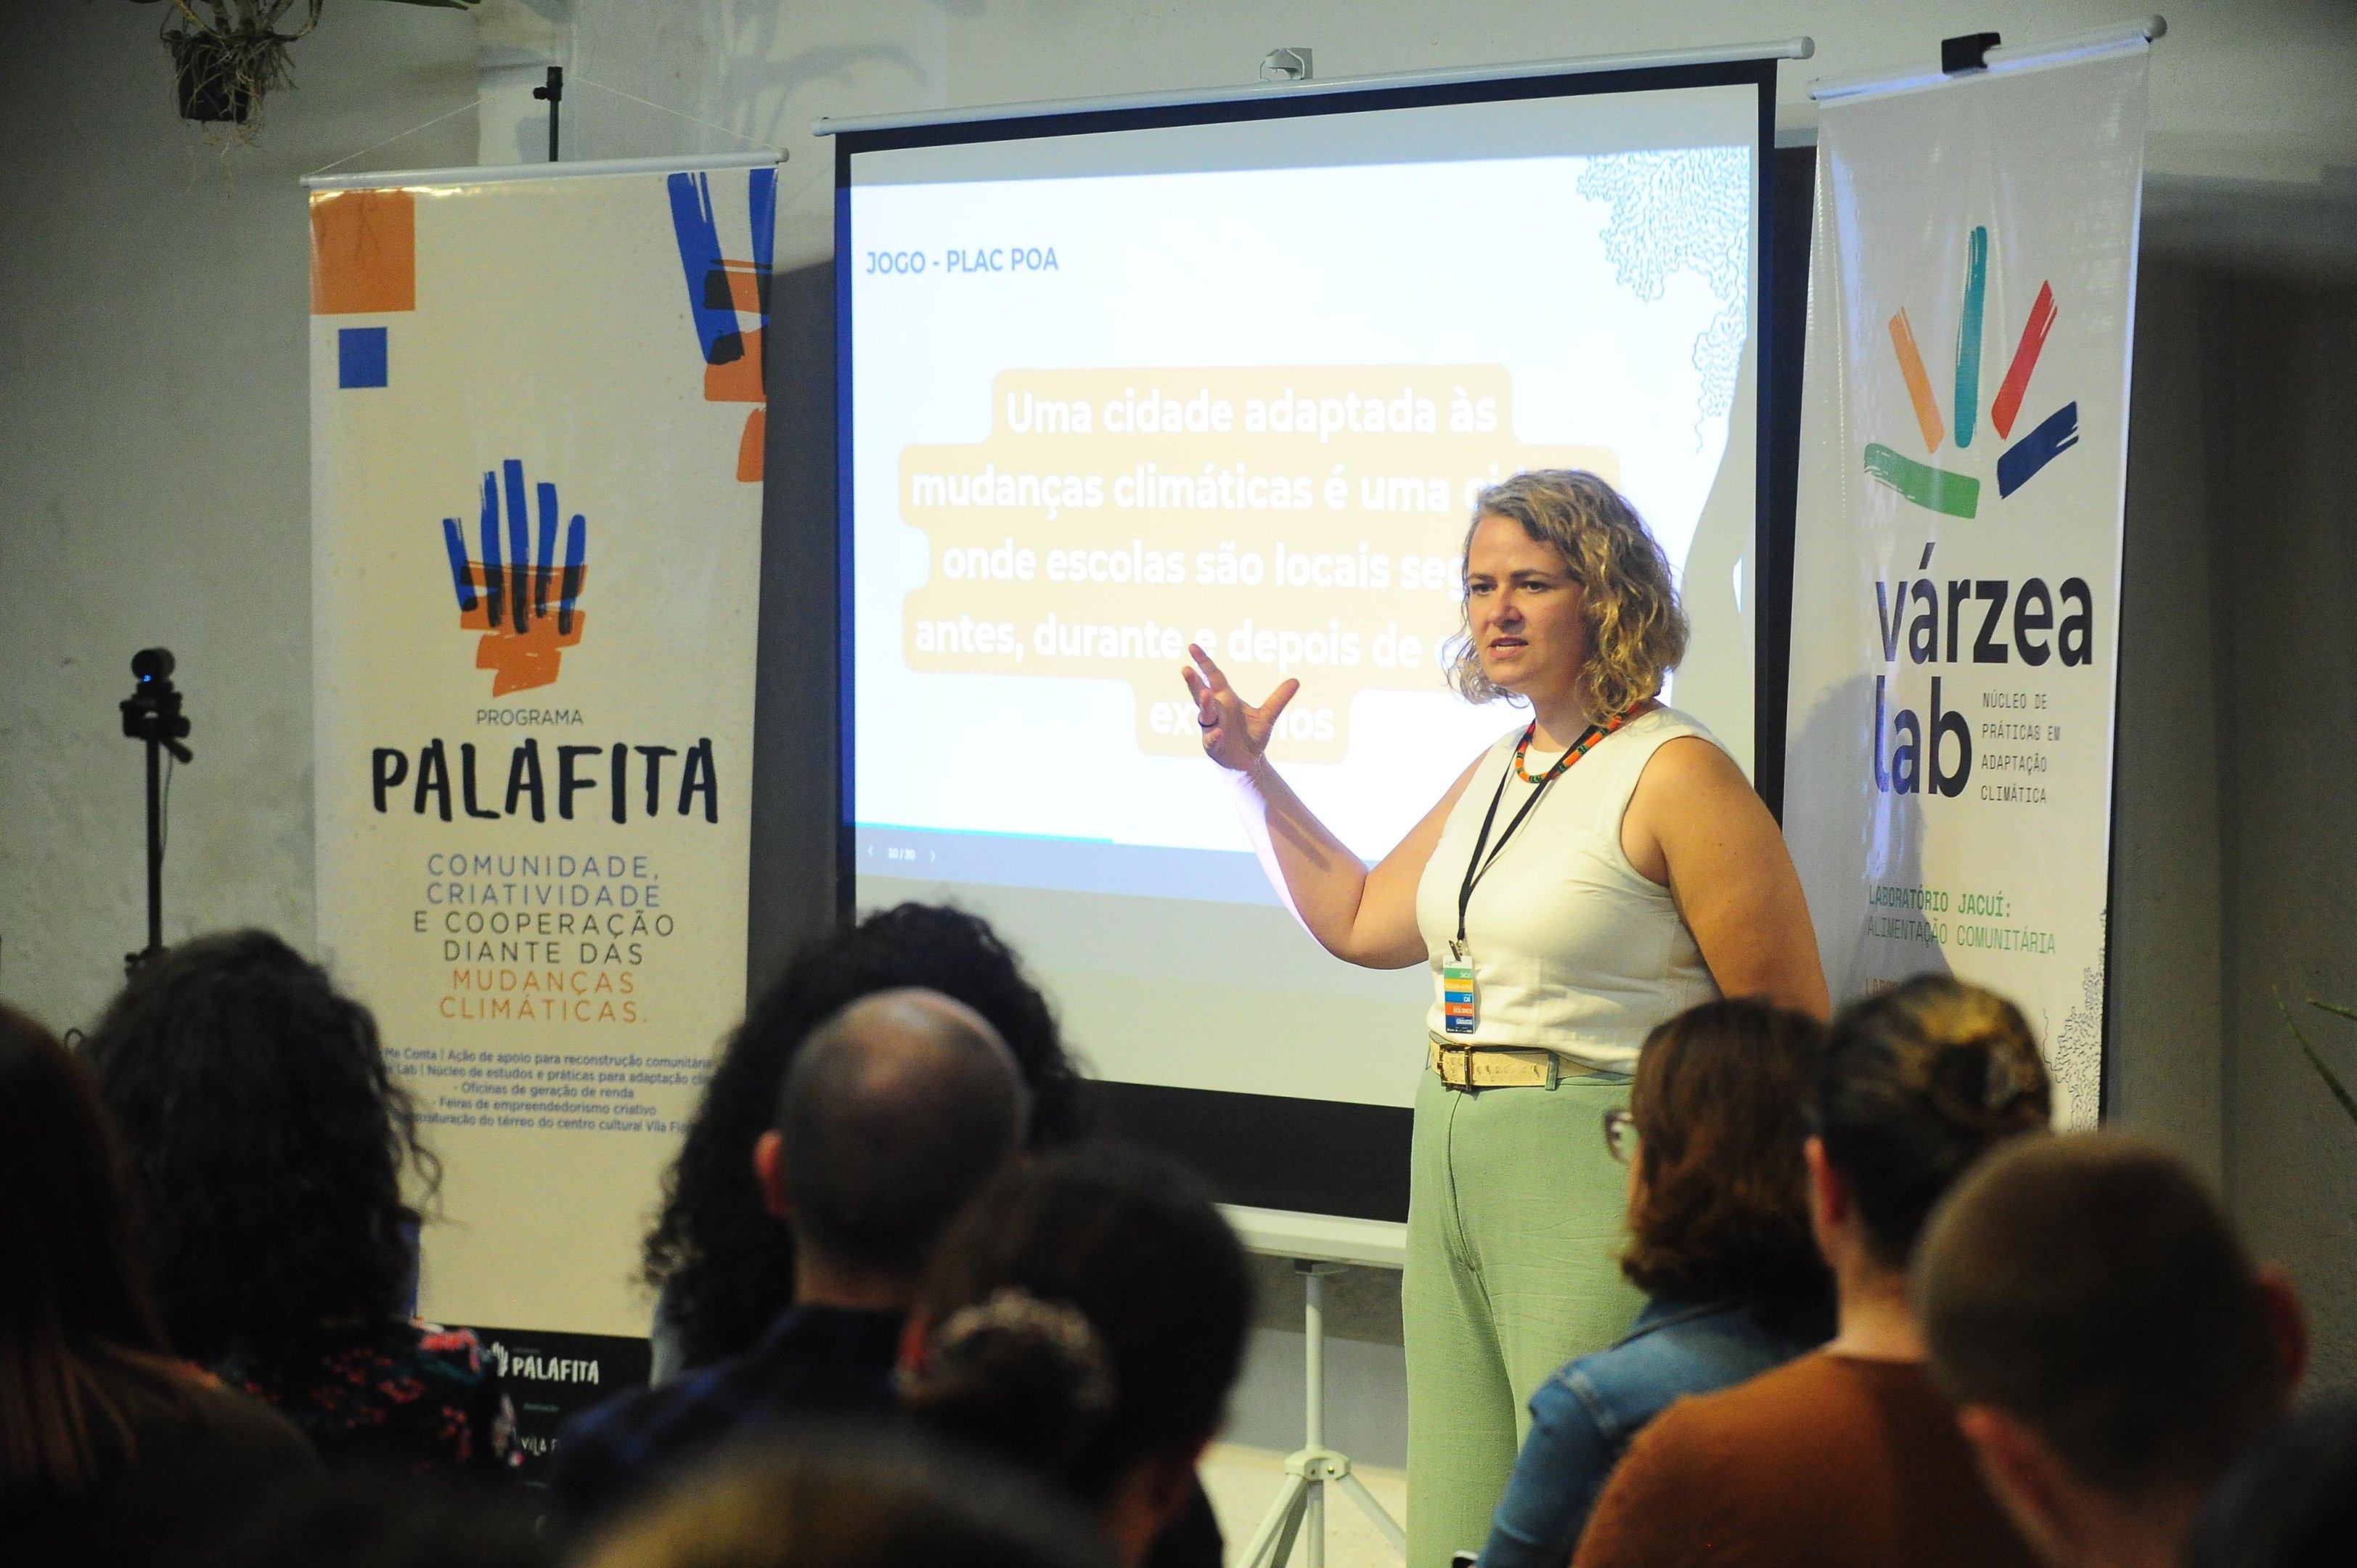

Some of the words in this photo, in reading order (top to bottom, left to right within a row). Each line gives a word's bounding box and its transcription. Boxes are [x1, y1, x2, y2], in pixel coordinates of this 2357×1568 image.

[867, 250, 926, 274] JOGO
[947, 249, 1004, 273] PLAC
[1011, 247, 1059, 271] POA
[1007, 392, 1092, 433] Uma
[1103, 387, 1234, 433] cidade
[1244, 387, 1437, 444] adaptada
[1450, 385, 1498, 432] às
[912, 463, 1104, 520] mudanças
[1114, 462, 1313, 510] climáticas
[1323, 464, 1349, 510] é
[1360, 475, 1450, 512] uma
[943, 536, 1037, 580] onde
[1045, 539, 1186, 584] escolas
[1196, 540, 1265, 586] são
[1275, 541, 1391, 589] locais
[1875, 542, 2093, 667] várzea
[915, 614, 1024, 663] antes,
[1032, 613, 1183, 659] durante
[1227, 618, 1361, 674] depois
[1372, 621, 1423, 669] de
[1982, 689, 2027, 709] NÚCLEO
[2034, 693, 2048, 710] DE
[476, 709, 584, 726] PROGRAMA
[1874, 675, 1972, 799] lab
[1981, 721, 2041, 742] PRÁTICAS
[2048, 724, 2061, 742] EM
[1980, 754, 2048, 777] ADAPTAÇÃO
[372, 738, 719, 825] PALAFITA
[1980, 785, 2047, 804] CLIMÁTICA
[426, 853, 660, 881] COMUNIDADE,
[426, 883, 660, 908] CRIATIVIDADE
[1868, 883, 1949, 912] LABORATÓRIO
[1957, 890, 2011, 918] JACUÍ:
[414, 911, 428, 934] E
[445, 909, 675, 941] COOPERAÇÃO
[1867, 915, 1948, 947] ALIMENTAÇÃO
[1956, 925, 2056, 955] COMUNITÁRIA
[444, 940, 562, 963] DIANTE
[579, 942, 644, 965] DAS
[453, 969, 634, 995] MUDANÇAS
[439, 995, 648, 1024] CLIMÁTICAS.
[404, 1048, 437, 1060] Conta
[448, 1048, 476, 1062] Ação
[479, 1050, 494, 1062] de
[497, 1051, 531, 1064] apoio
[535, 1054, 561, 1065] para
[564, 1053, 643, 1068] reconstrução
[427, 1065, 466, 1077] Núcleo
[469, 1067, 483, 1077] de
[486, 1068, 534, 1079] estudos
[547, 1070, 595, 1082] práticas
[598, 1072, 626, 1083] para
[629, 1071, 688, 1085] adaptação
[462, 1082, 507, 1095] Oficinas
[511, 1084, 526, 1095] de
[531, 1085, 578, 1098] geração
[581, 1087, 596, 1097] de
[600, 1087, 634, 1099] renda
[439, 1096, 473, 1108] Feiras
[475, 1098, 489, 1108] de
[493, 1100, 610, 1114] empreendedorismo
[614, 1104, 657, 1116] criativo
[479, 1115, 494, 1126] do
[497, 1116, 535, 1127] térreo
[539, 1116, 554, 1128] do
[557, 1119, 595, 1130] centro
[599, 1121, 643, 1132] cultural
[646, 1121, 667, 1133] Vila
[512, 1355, 600, 1385] PALAFITA
